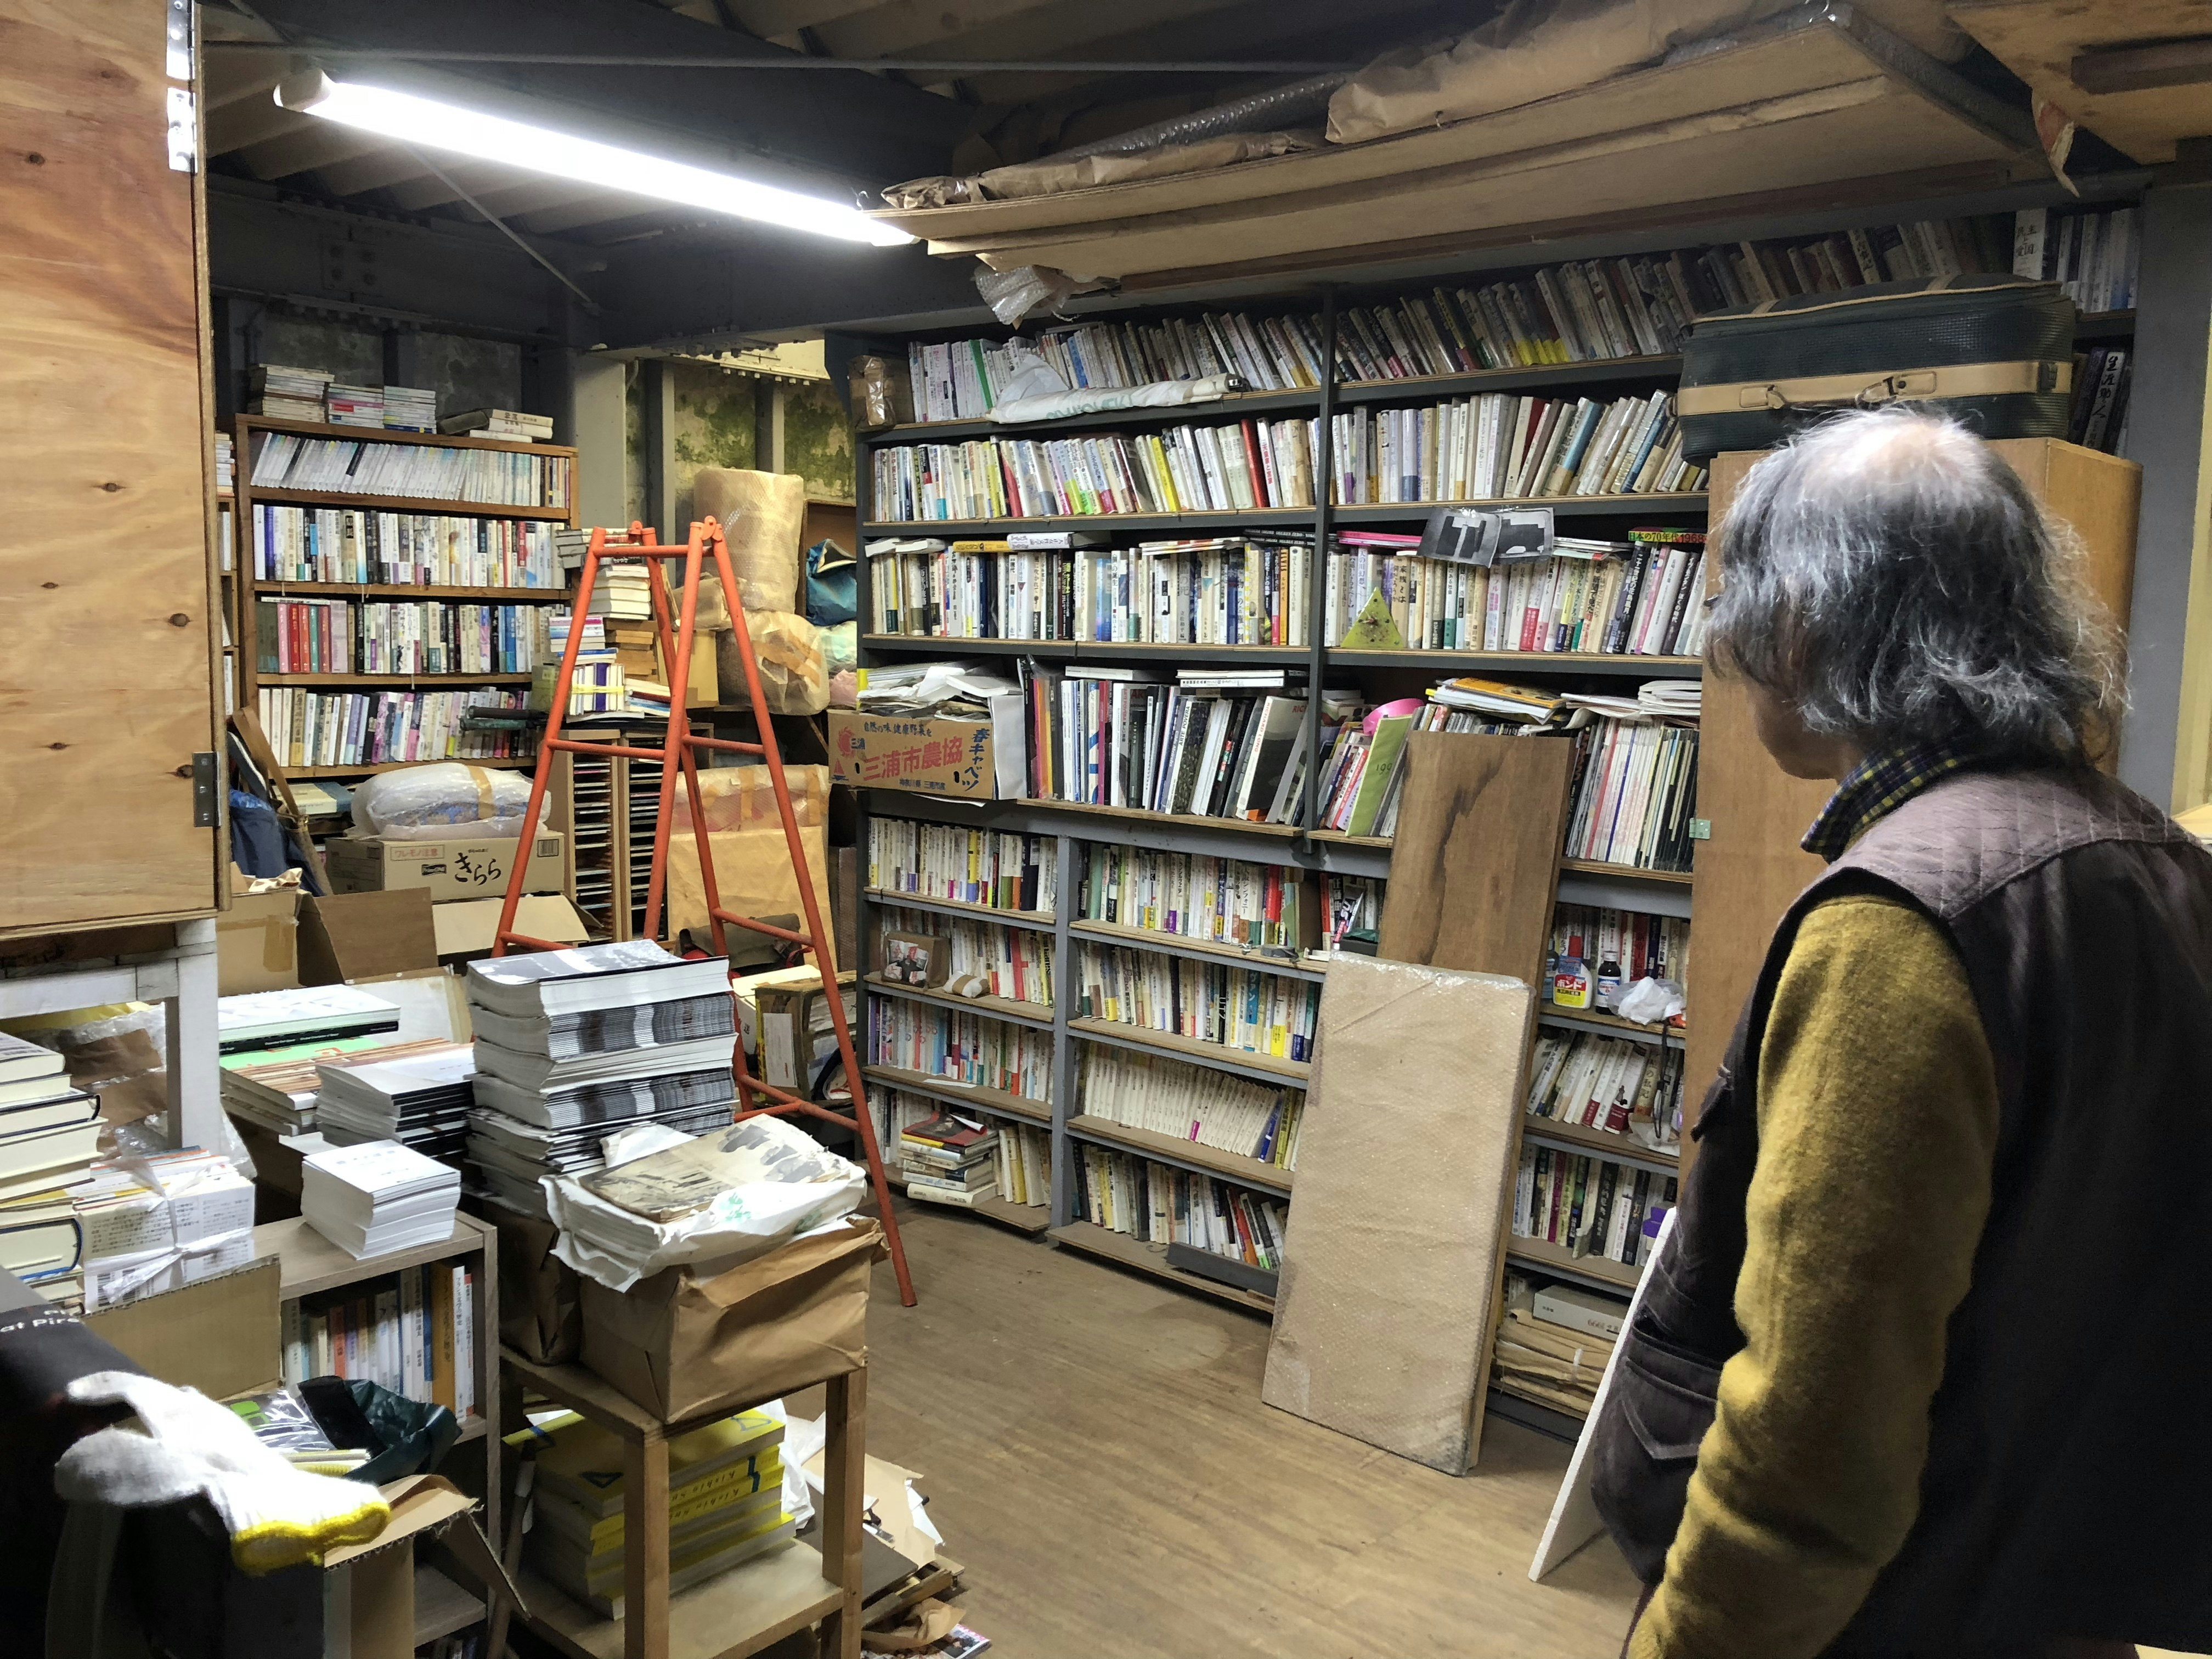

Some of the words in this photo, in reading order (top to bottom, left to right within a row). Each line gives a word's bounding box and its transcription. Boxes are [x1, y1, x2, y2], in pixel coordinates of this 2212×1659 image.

[1629, 532, 1679, 543] 日本の70年代
[864, 721, 891, 733] 自然の味
[1181, 706, 1190, 729] POVERA
[1260, 702, 1271, 733] RICHARD
[864, 736, 963, 781] 三浦市農協
[962, 728, 990, 792] 春キャベツ
[394, 848, 438, 858] ワレモノ注意
[454, 852, 501, 886] きらら
[1557, 979, 1583, 990] ボンド
